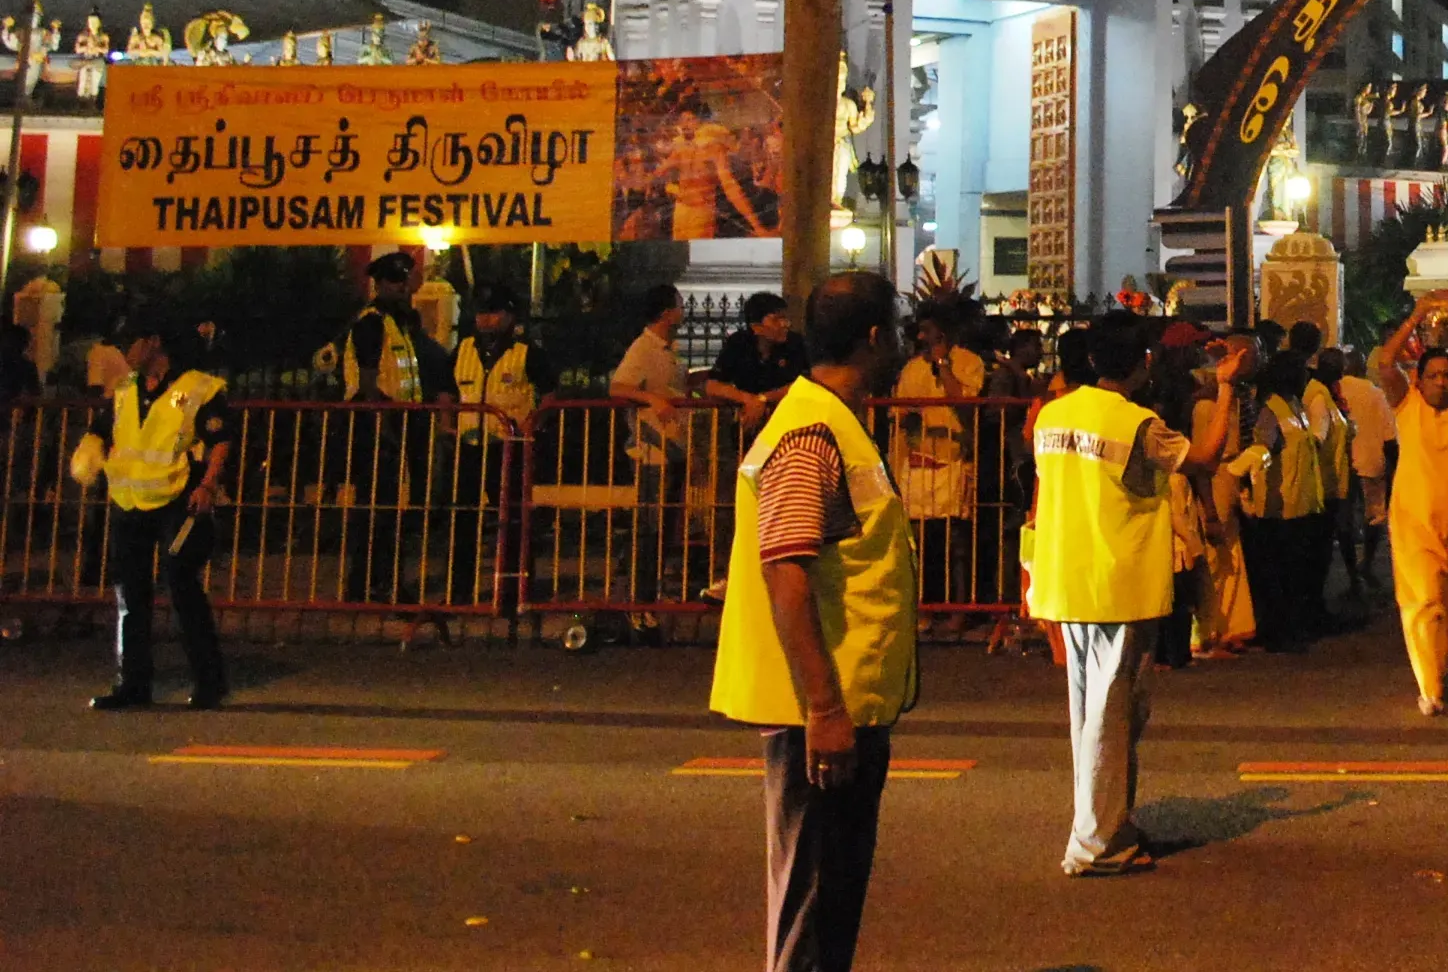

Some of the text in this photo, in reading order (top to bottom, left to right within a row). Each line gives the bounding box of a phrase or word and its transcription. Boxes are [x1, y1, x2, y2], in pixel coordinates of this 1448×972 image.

[118, 113, 594, 189] தைப்பூசத் திருவிழா
[153, 192, 553, 231] THAIPUSAM FESTIVAL
